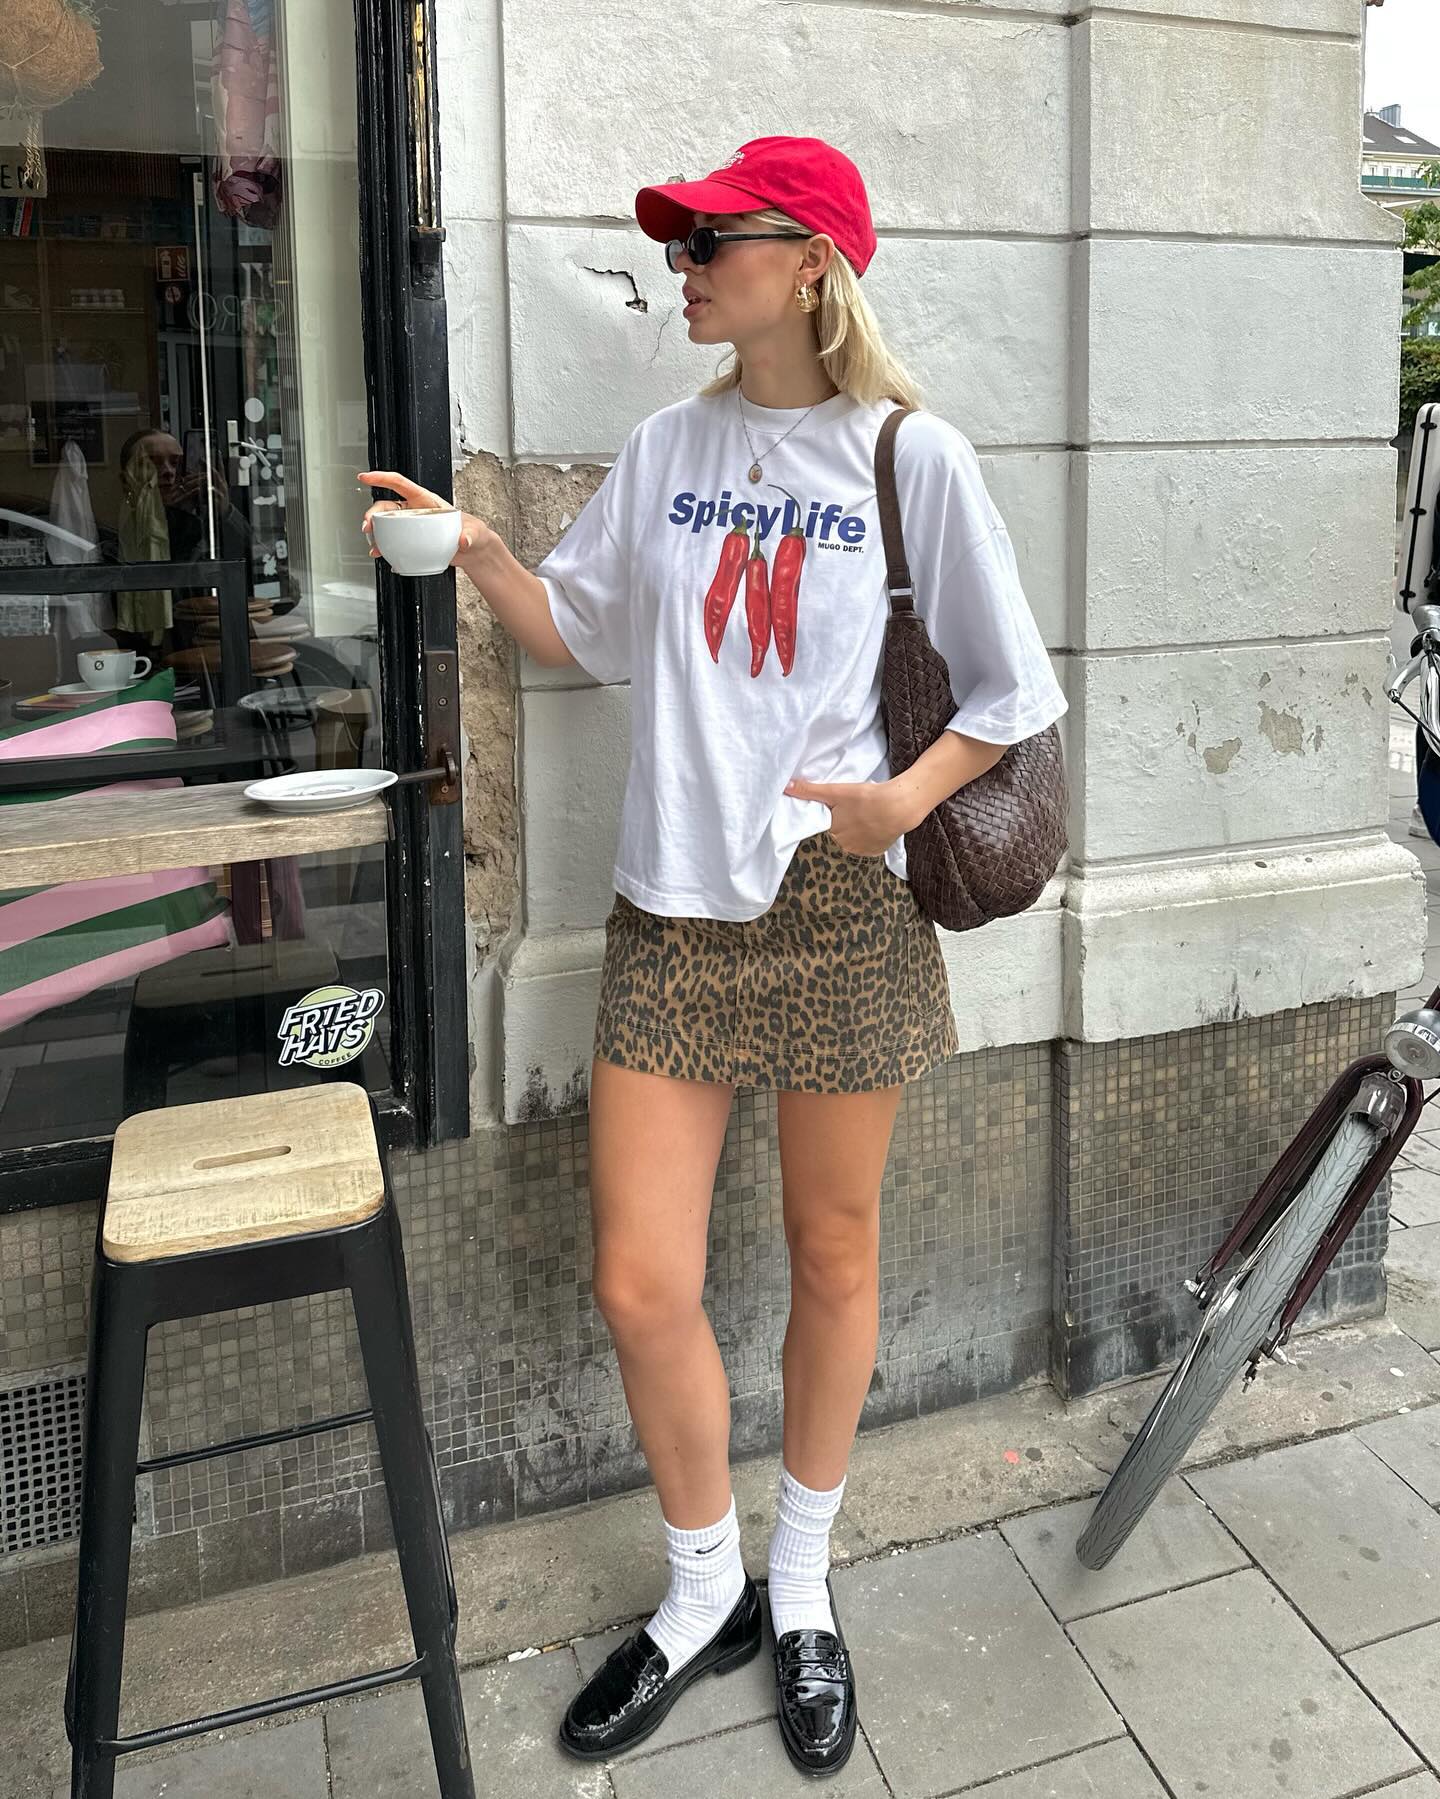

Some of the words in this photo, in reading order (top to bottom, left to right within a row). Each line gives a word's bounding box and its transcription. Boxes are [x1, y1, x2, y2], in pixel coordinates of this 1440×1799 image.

[817, 541, 841, 551] MUGO
[843, 544, 865, 554] DEPT.
[280, 990, 380, 1039] FRIED
[280, 1018, 369, 1063] HATS
[318, 1052, 352, 1065] COFFEE
